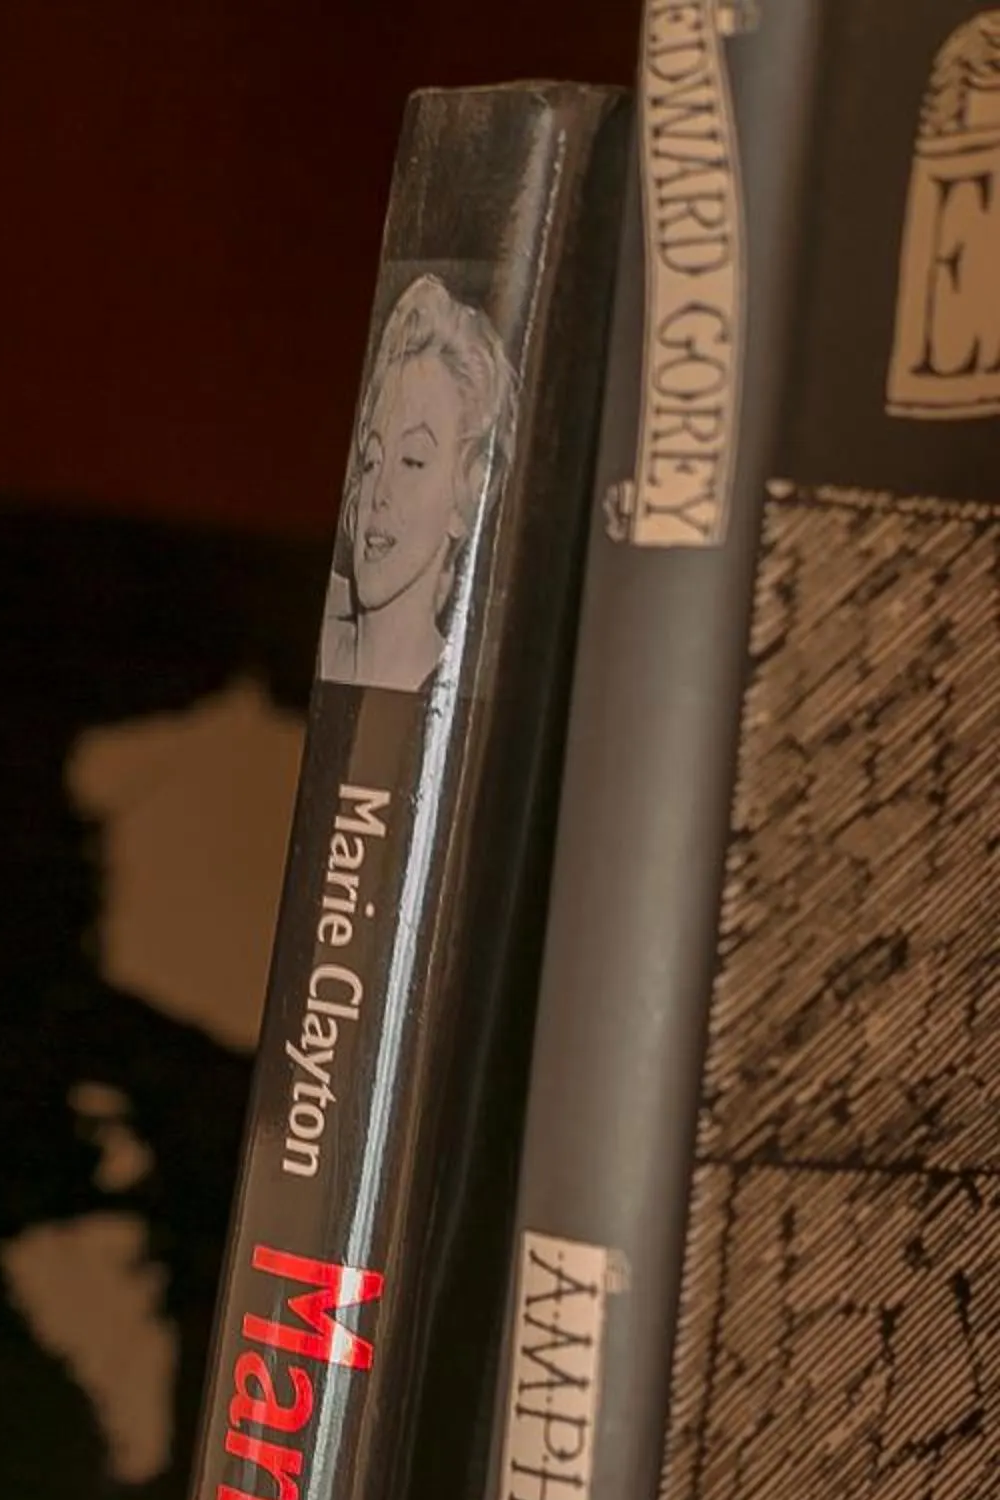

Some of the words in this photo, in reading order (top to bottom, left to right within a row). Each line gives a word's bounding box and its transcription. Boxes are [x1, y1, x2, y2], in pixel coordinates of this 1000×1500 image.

[648, 0, 732, 276] EDWARD
[646, 303, 730, 536] GOREY
[317, 783, 391, 947] Marie
[283, 963, 364, 1179] Clayton
